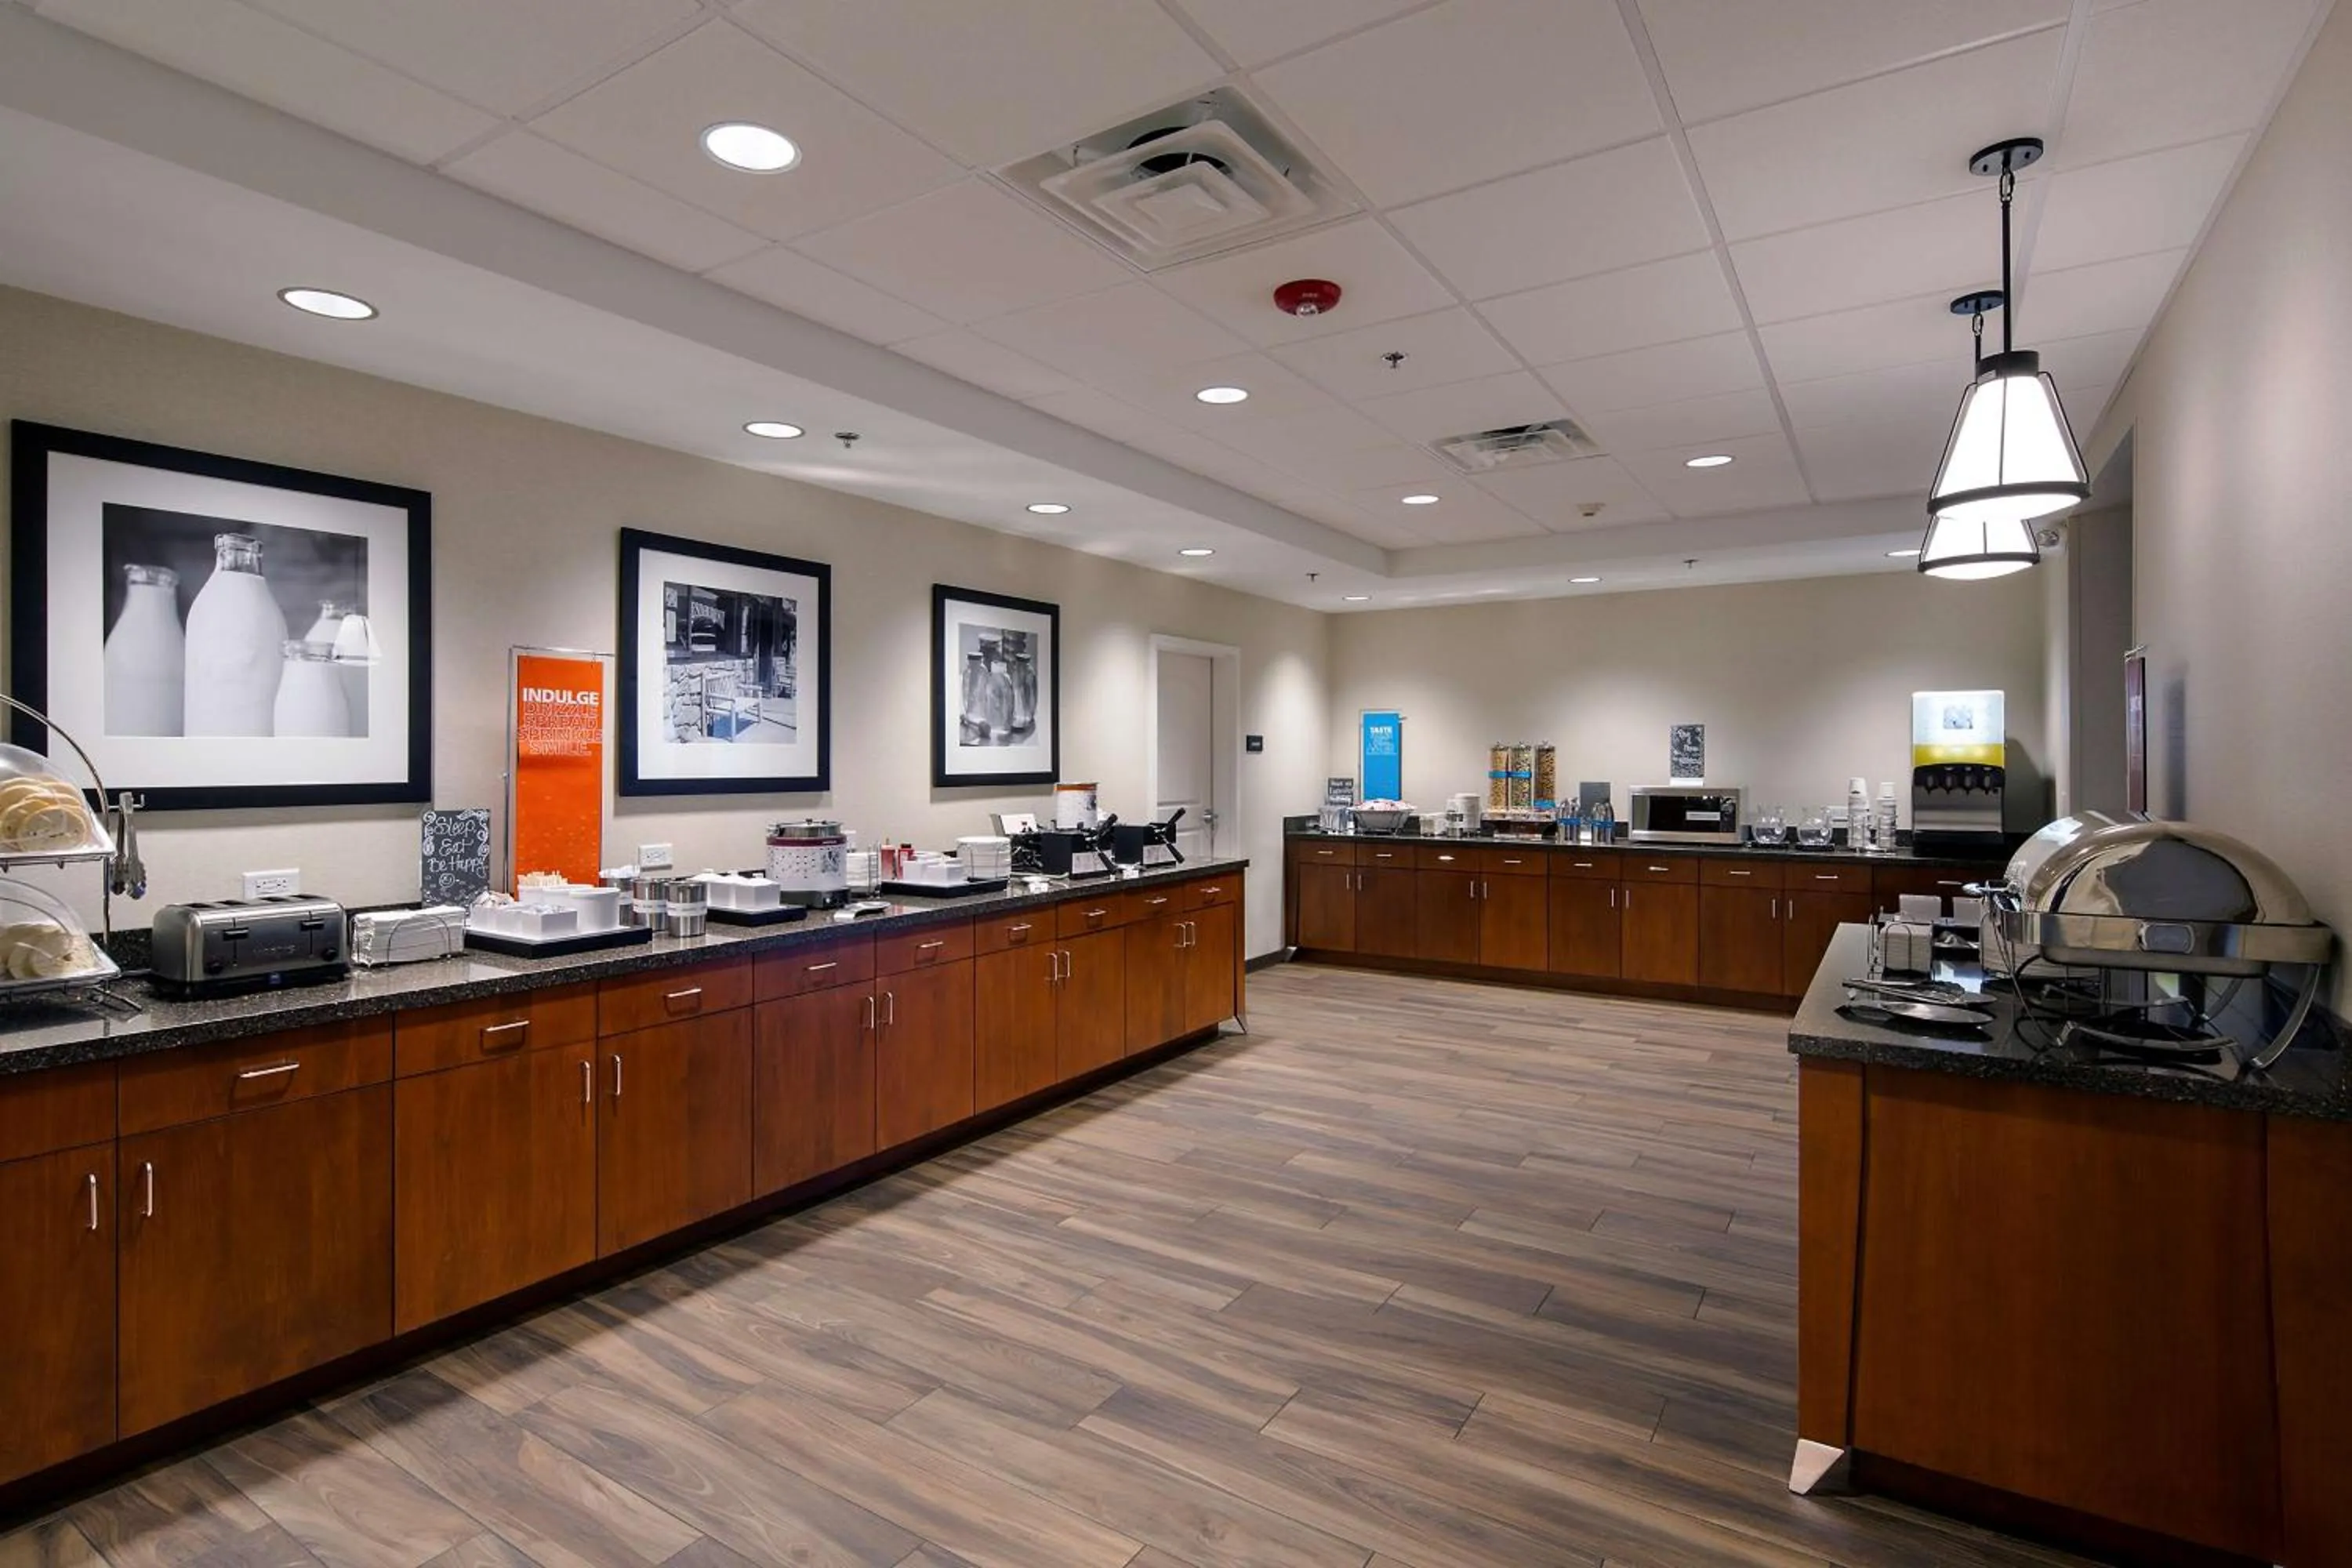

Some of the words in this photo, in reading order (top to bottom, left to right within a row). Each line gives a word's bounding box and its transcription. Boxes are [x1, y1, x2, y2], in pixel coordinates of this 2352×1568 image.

[522, 688, 600, 706] INDULGE
[524, 702, 599, 718] DRIZZLE
[524, 714, 599, 729] SPREAD
[517, 728, 603, 743] SPRINKLE
[528, 740, 593, 757] SMILE
[439, 838, 474, 857] Eat
[426, 857, 448, 873] Be
[448, 854, 487, 879] Happy
